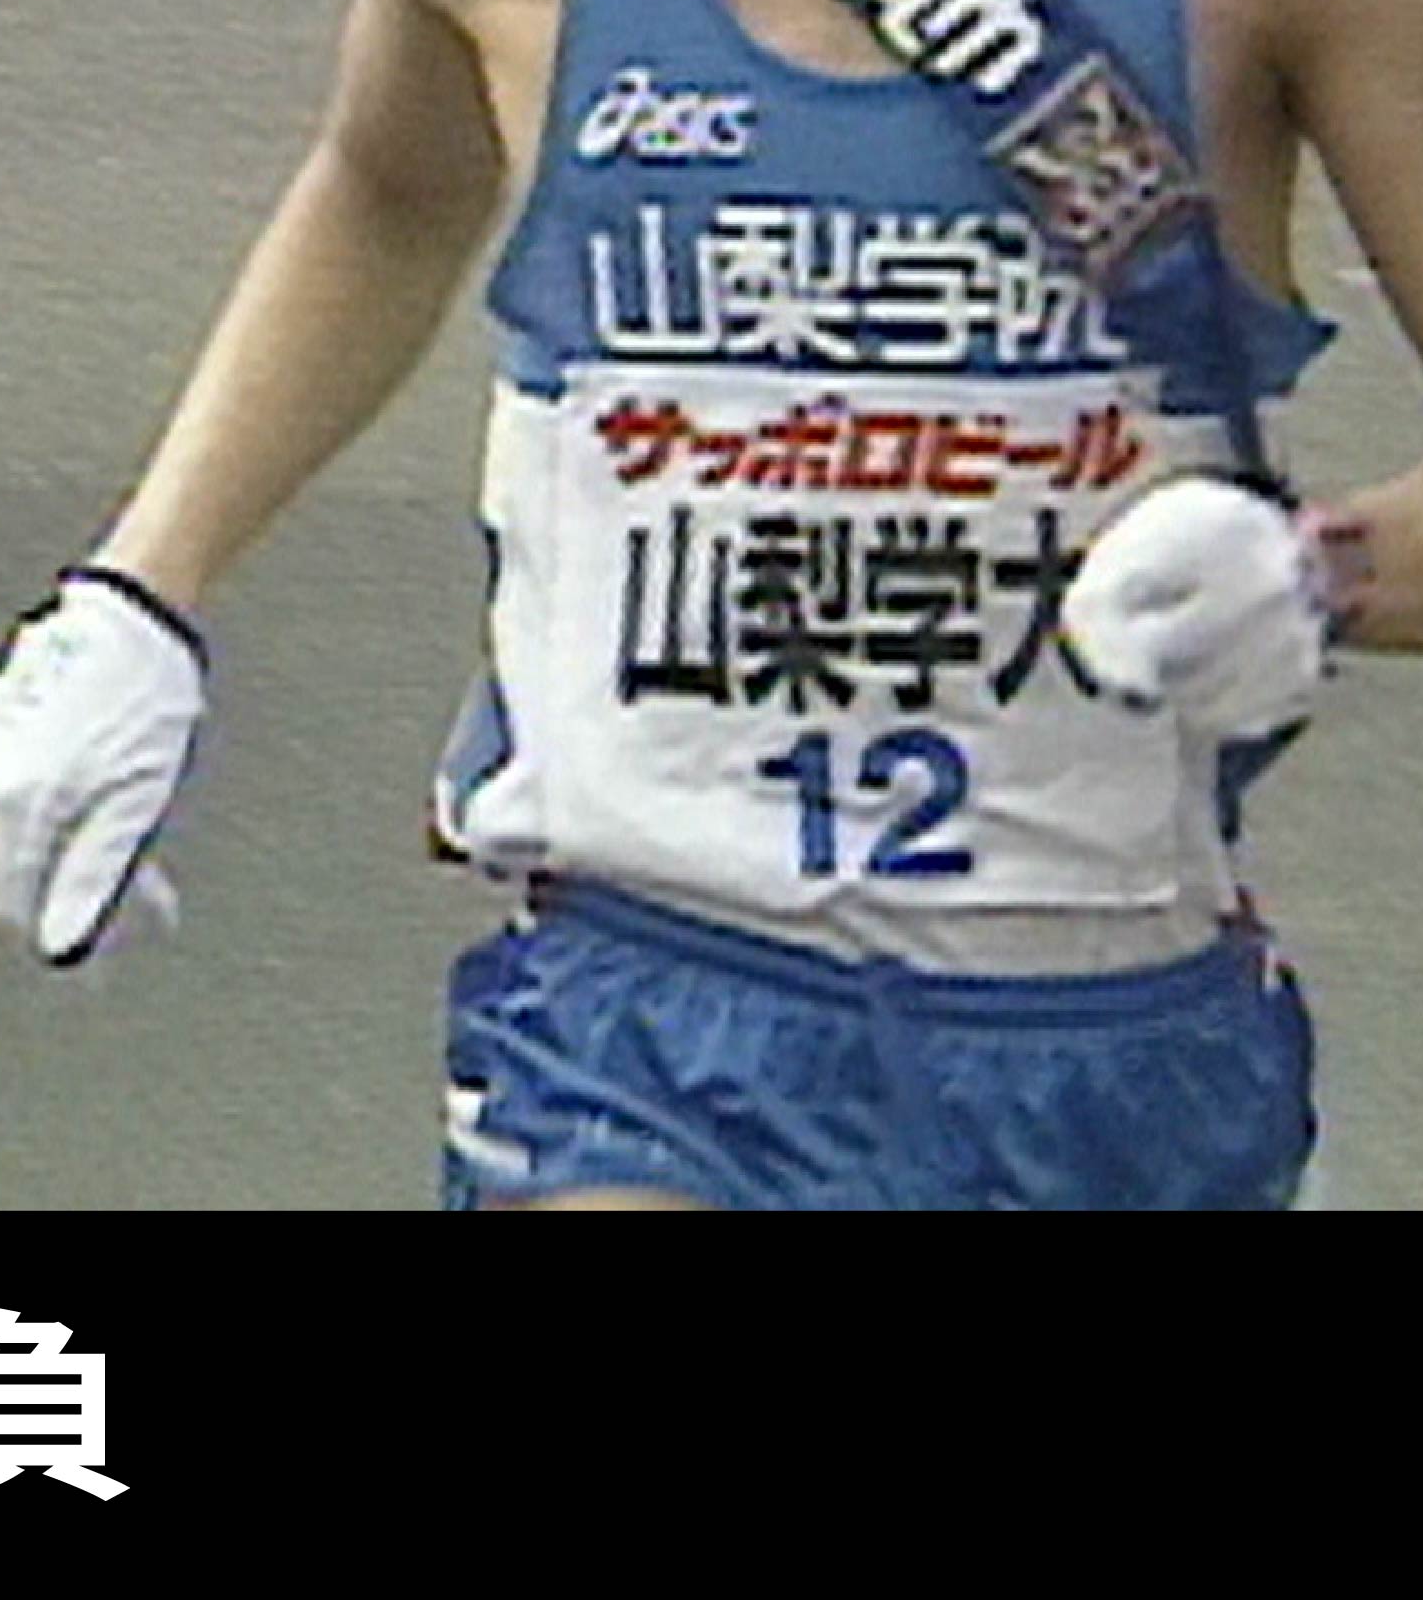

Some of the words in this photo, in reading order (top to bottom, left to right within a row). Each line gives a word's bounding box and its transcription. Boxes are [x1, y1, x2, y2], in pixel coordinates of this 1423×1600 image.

[594, 396, 1142, 496] サッポロビール
[756, 730, 974, 877] 12
